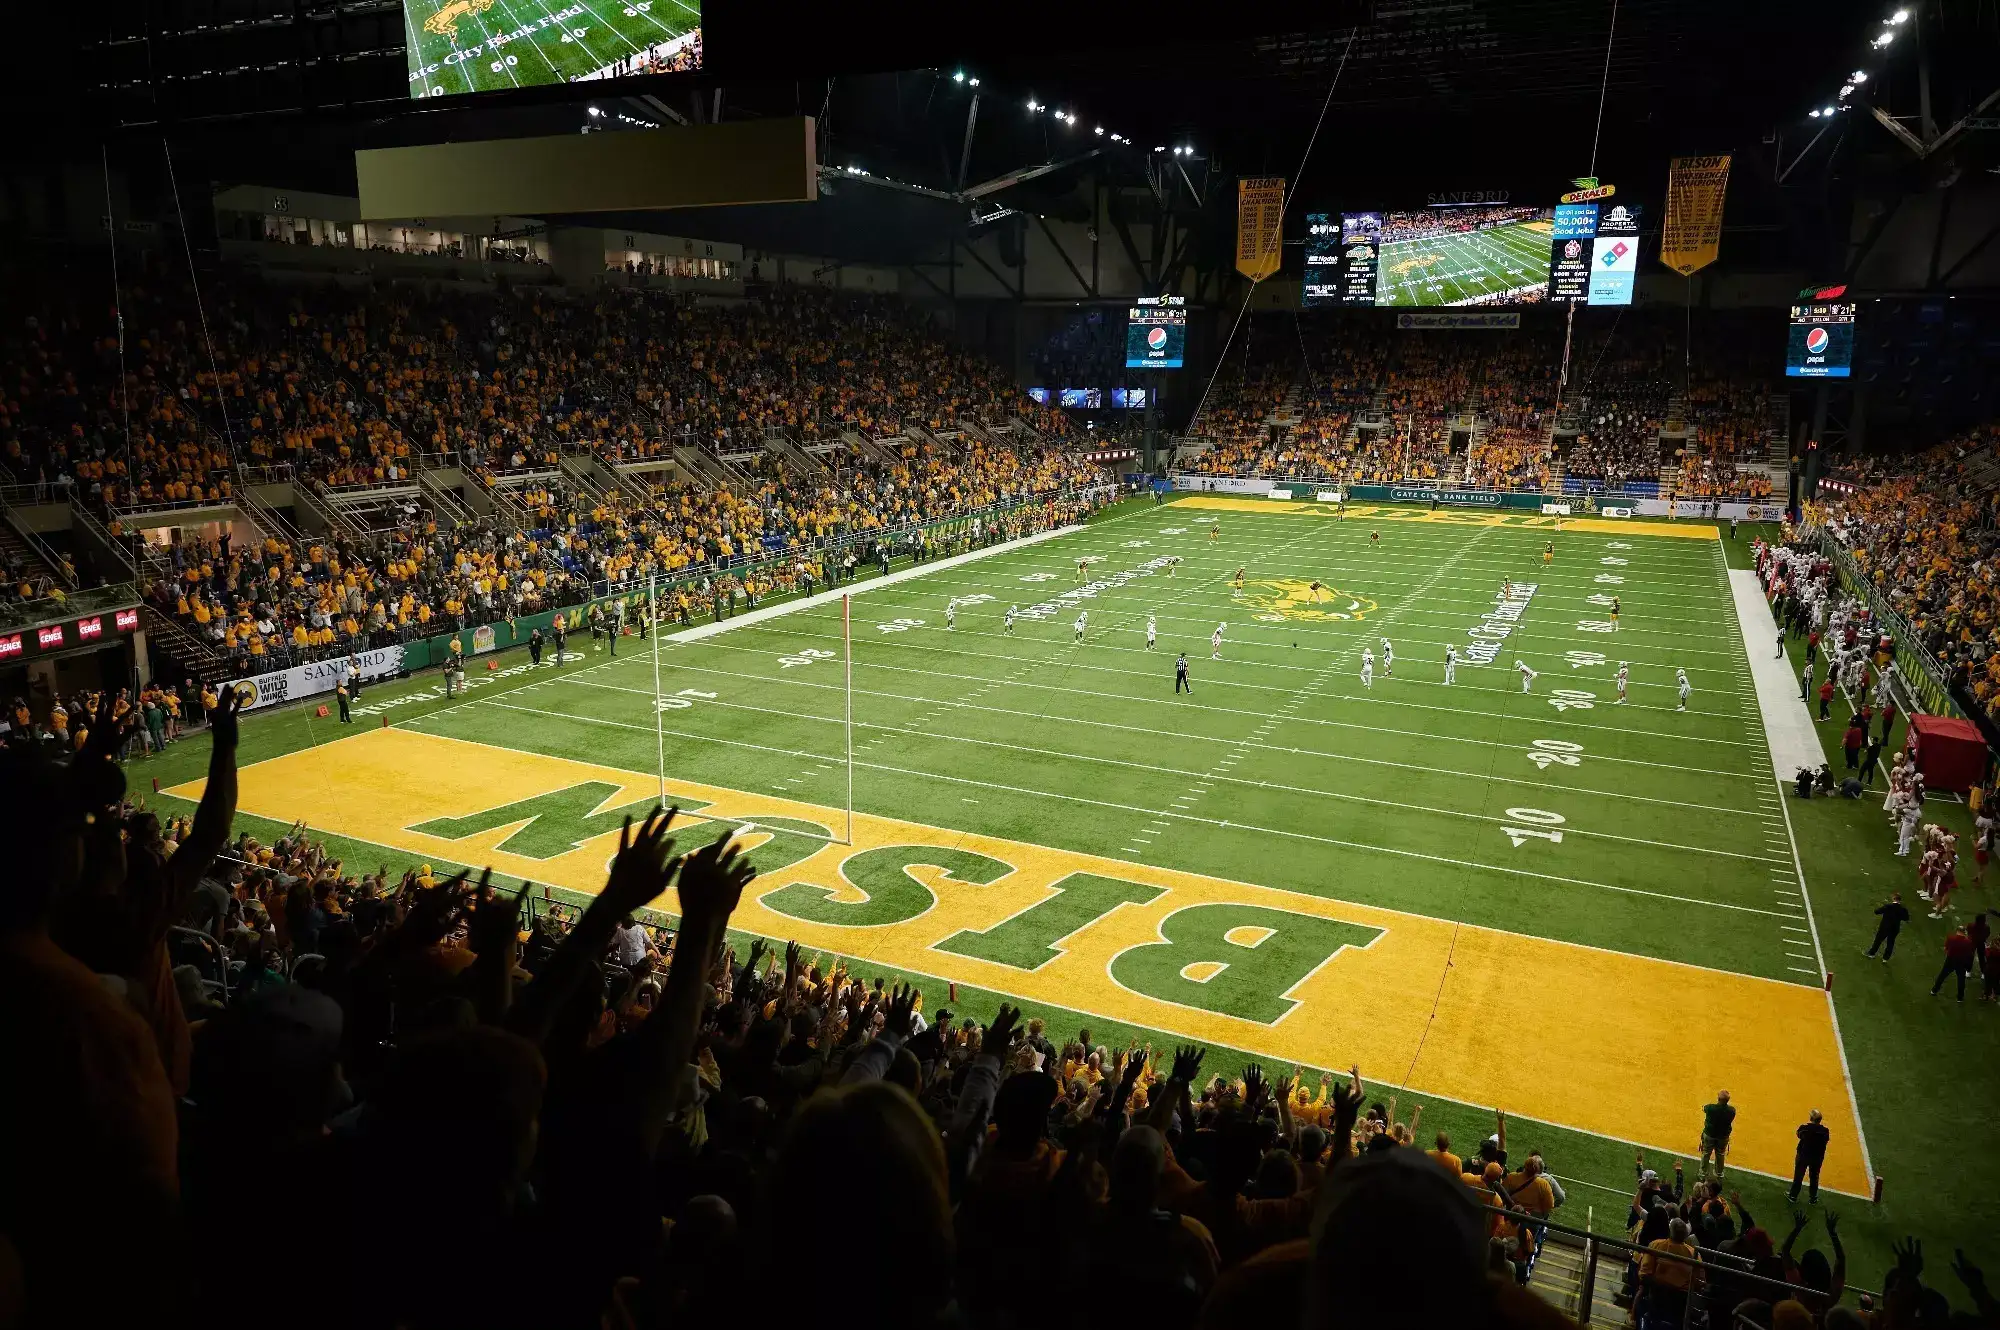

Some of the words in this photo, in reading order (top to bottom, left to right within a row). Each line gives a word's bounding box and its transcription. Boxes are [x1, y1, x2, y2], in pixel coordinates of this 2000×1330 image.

[443, 43, 483, 65] City
[486, 24, 538, 50] Bank
[538, 5, 585, 28] Field
[560, 27, 587, 45] 40
[490, 55, 518, 73] 50
[1245, 179, 1278, 189] BISON
[1244, 191, 1278, 199] NATIONAL
[1427, 189, 1511, 204] SANFORD
[1569, 188, 1608, 201] DEKALB
[1242, 198, 1280, 206] CHAMPIONS
[1557, 217, 1595, 226] 50,000+
[1576, 227, 1594, 235] Jobs
[1840, 306, 1849, 315] 21
[1438, 316, 1458, 328] City
[1807, 356, 1825, 364] pepsi
[1807, 441, 1818, 450] 14
[1208, 479, 1246, 487] SANFORD
[1470, 494, 1495, 502] FIELD
[1479, 600, 1530, 622] Bank
[116, 615, 138, 626] CENEX
[79, 623, 102, 635] CENEX
[1467, 619, 1525, 640] City
[40, 631, 63, 643] CENEX
[777, 648, 836, 665] 20
[1456, 638, 1502, 664] Gate
[258, 673, 287, 685] BUFFALO
[259, 680, 288, 694] WILD
[261, 689, 289, 703] WINGS
[652, 688, 718, 711] 10
[1548, 689, 1596, 709] 30
[349, 692, 438, 716] Bank
[1527, 739, 1584, 767] 20
[1500, 807, 1566, 843] 10
[402, 781, 1389, 1026] BISON
